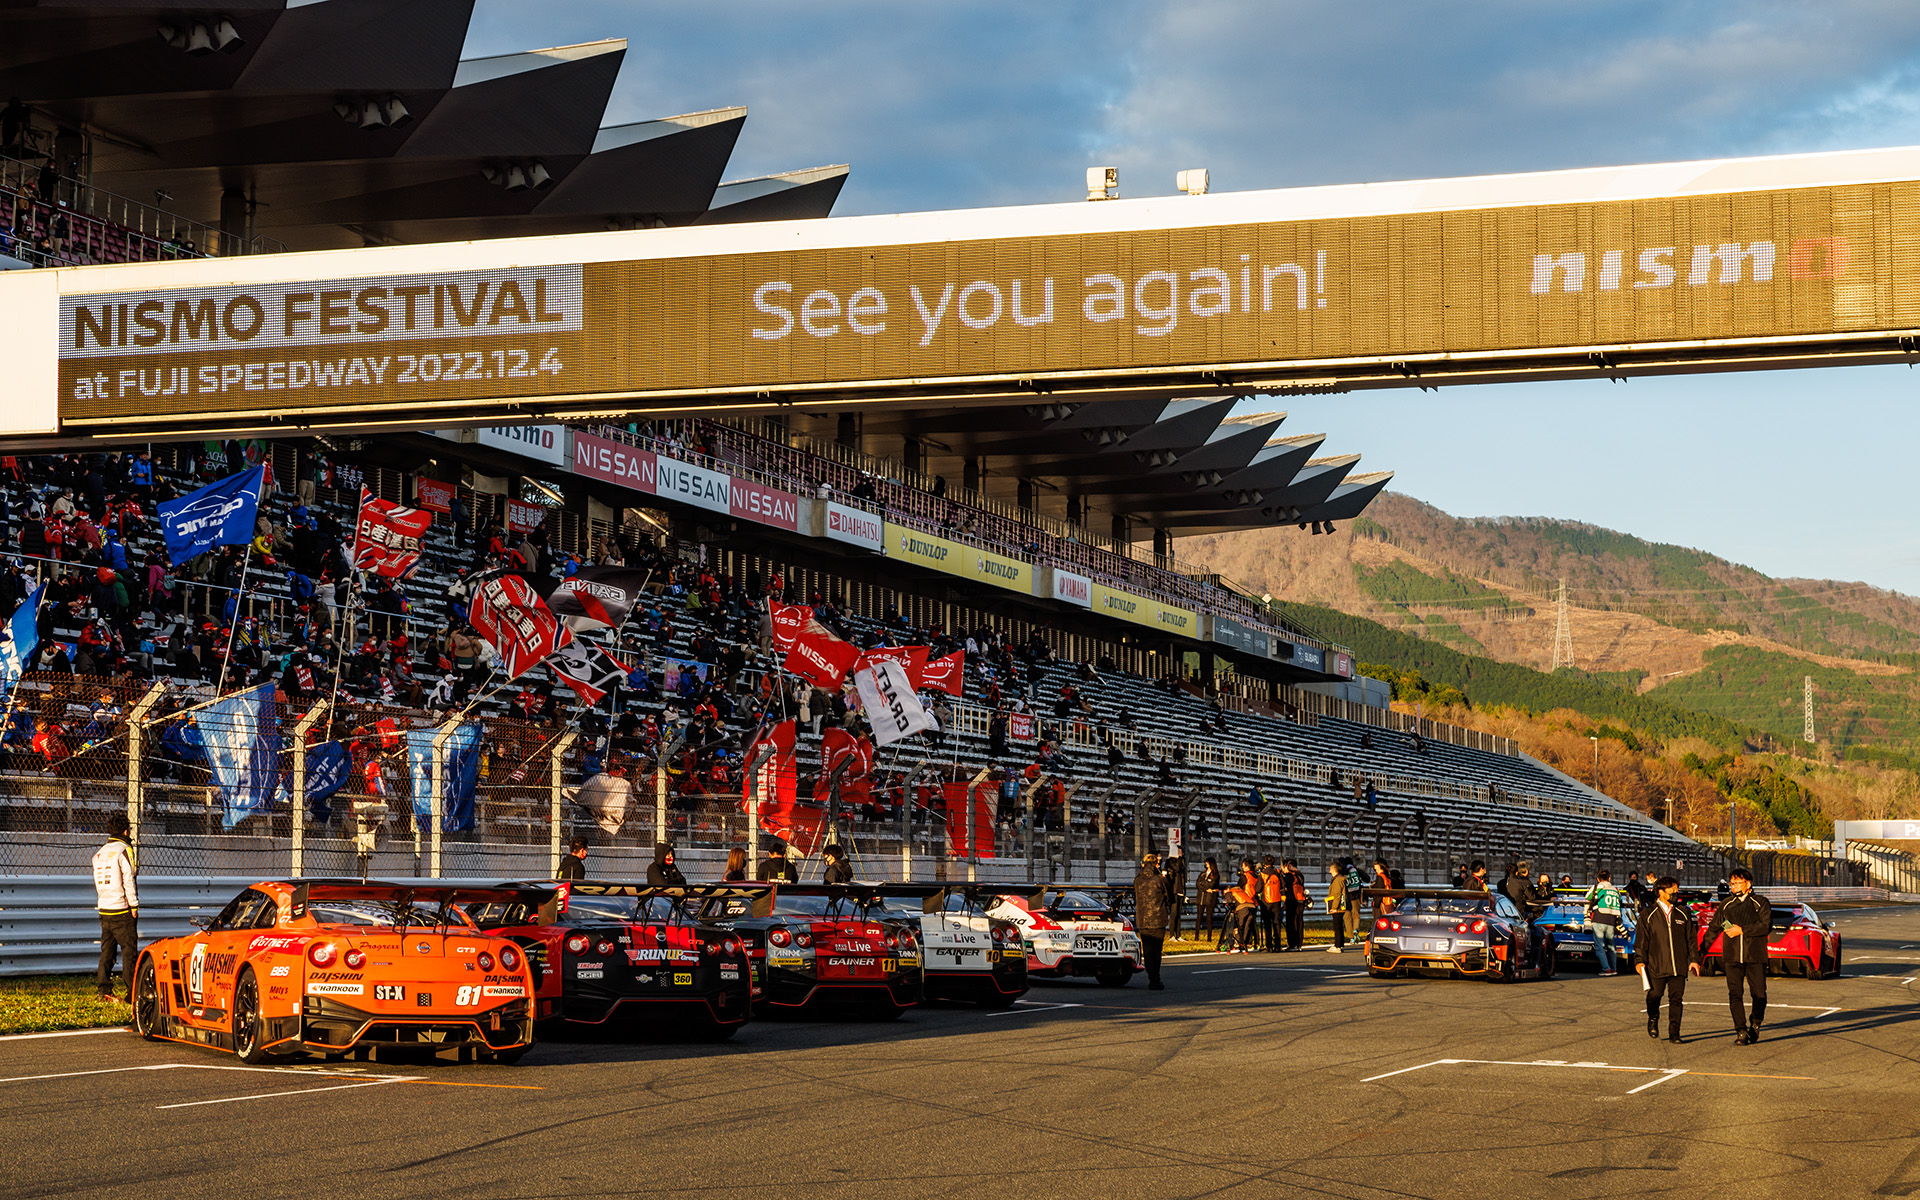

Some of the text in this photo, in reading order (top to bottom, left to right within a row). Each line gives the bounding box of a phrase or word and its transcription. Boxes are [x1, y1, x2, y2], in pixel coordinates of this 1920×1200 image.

[1531, 236, 1850, 296] nismo
[752, 249, 1327, 347] See you again!
[74, 278, 563, 349] NISMO FESTIVAL
[75, 348, 563, 399] at FUJI SPEEDWAY 2022.12.4
[577, 441, 654, 485] NISSAN
[659, 464, 728, 504] NISSAN
[732, 486, 795, 523] NISSAN
[841, 513, 880, 542] DAIHATSU
[908, 538, 948, 561] DUNLOP
[984, 559, 1019, 580] DUNLOP
[1065, 577, 1087, 601] YAMAHA
[1108, 596, 1137, 614] DUNLOP
[1162, 611, 1187, 628] DUNLOP
[1304, 652, 1319, 665] SUBARU
[573, 886, 767, 899] RIVAUX
[727, 907, 747, 915] GT3
[848, 941, 871, 952] Live
[953, 933, 976, 944] Live
[638, 949, 683, 961] RUNUP
[936, 948, 980, 956] GAINER
[987, 951, 999, 962] 10
[828, 957, 875, 966] GAINER
[883, 959, 895, 971] 11
[191, 954, 203, 990] 81
[270, 966, 290, 977] BBS
[309, 972, 364, 982] DAISHIN
[675, 975, 692, 984] 360
[484, 975, 524, 985] DAISHIN
[376, 985, 403, 1000] ST-X
[455, 985, 482, 1006] 81
